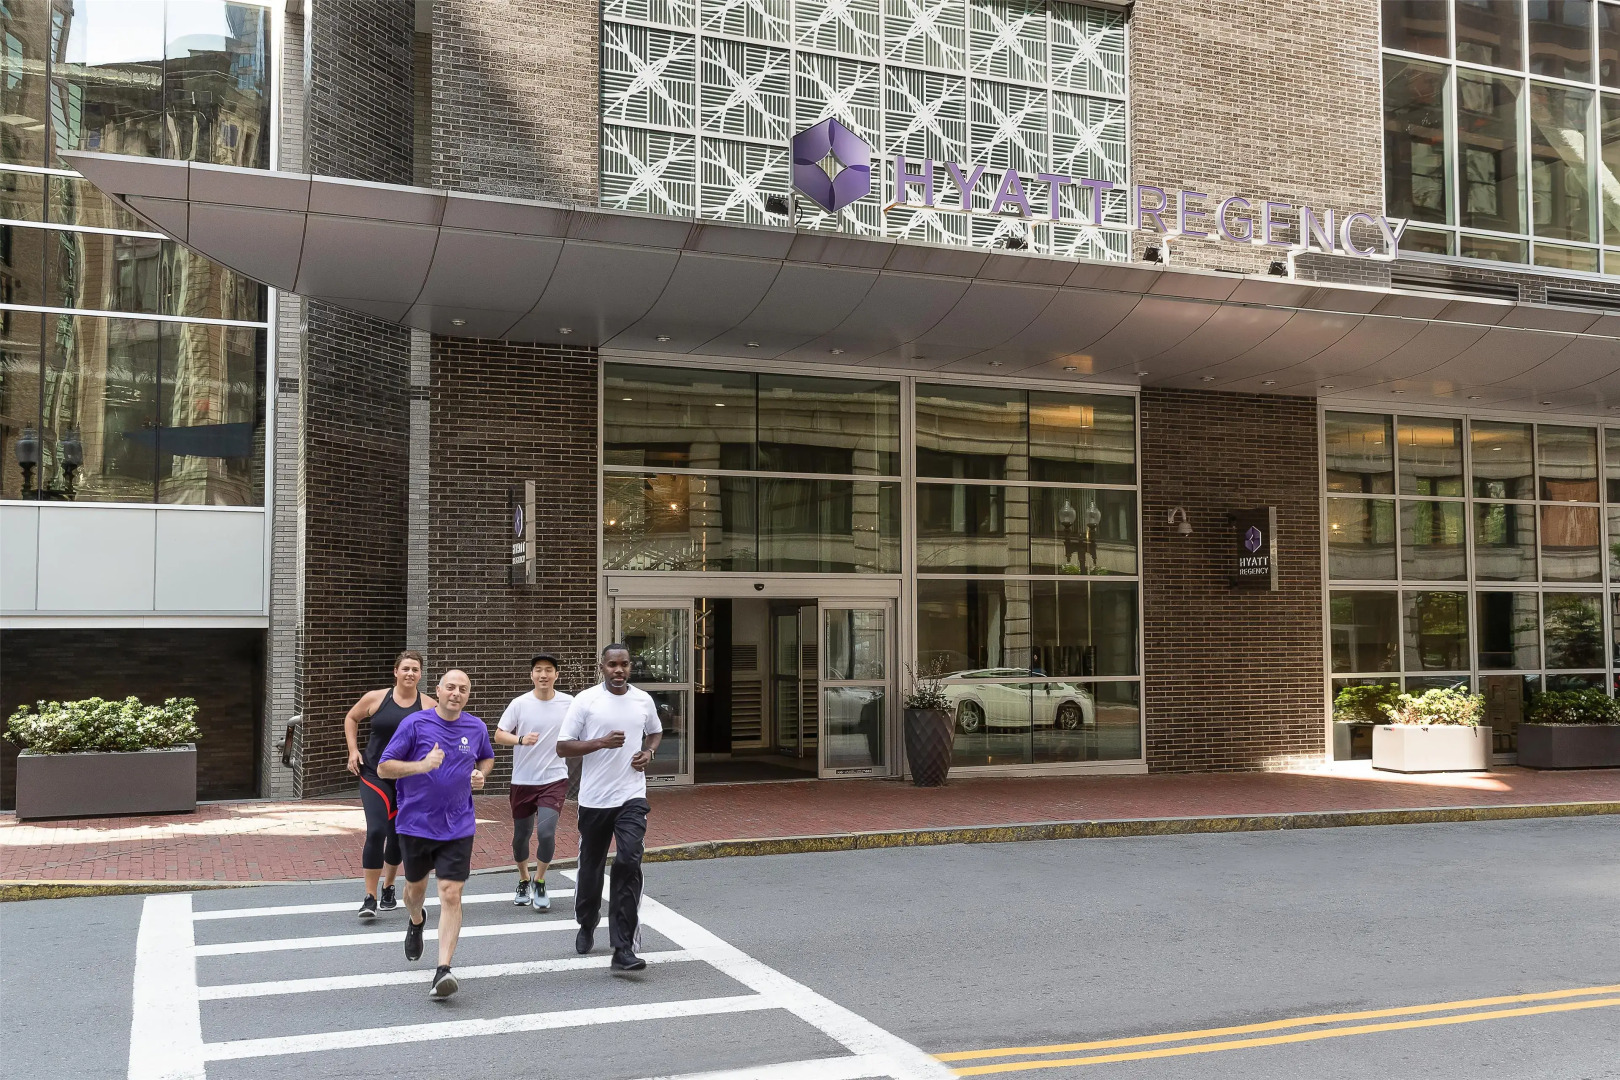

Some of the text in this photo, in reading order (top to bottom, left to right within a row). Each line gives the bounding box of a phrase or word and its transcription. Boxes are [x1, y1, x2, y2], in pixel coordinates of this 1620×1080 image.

[894, 155, 1409, 259] HYATT REGENCY
[1239, 556, 1268, 567] HYATT
[1239, 567, 1268, 575] REGENCY
